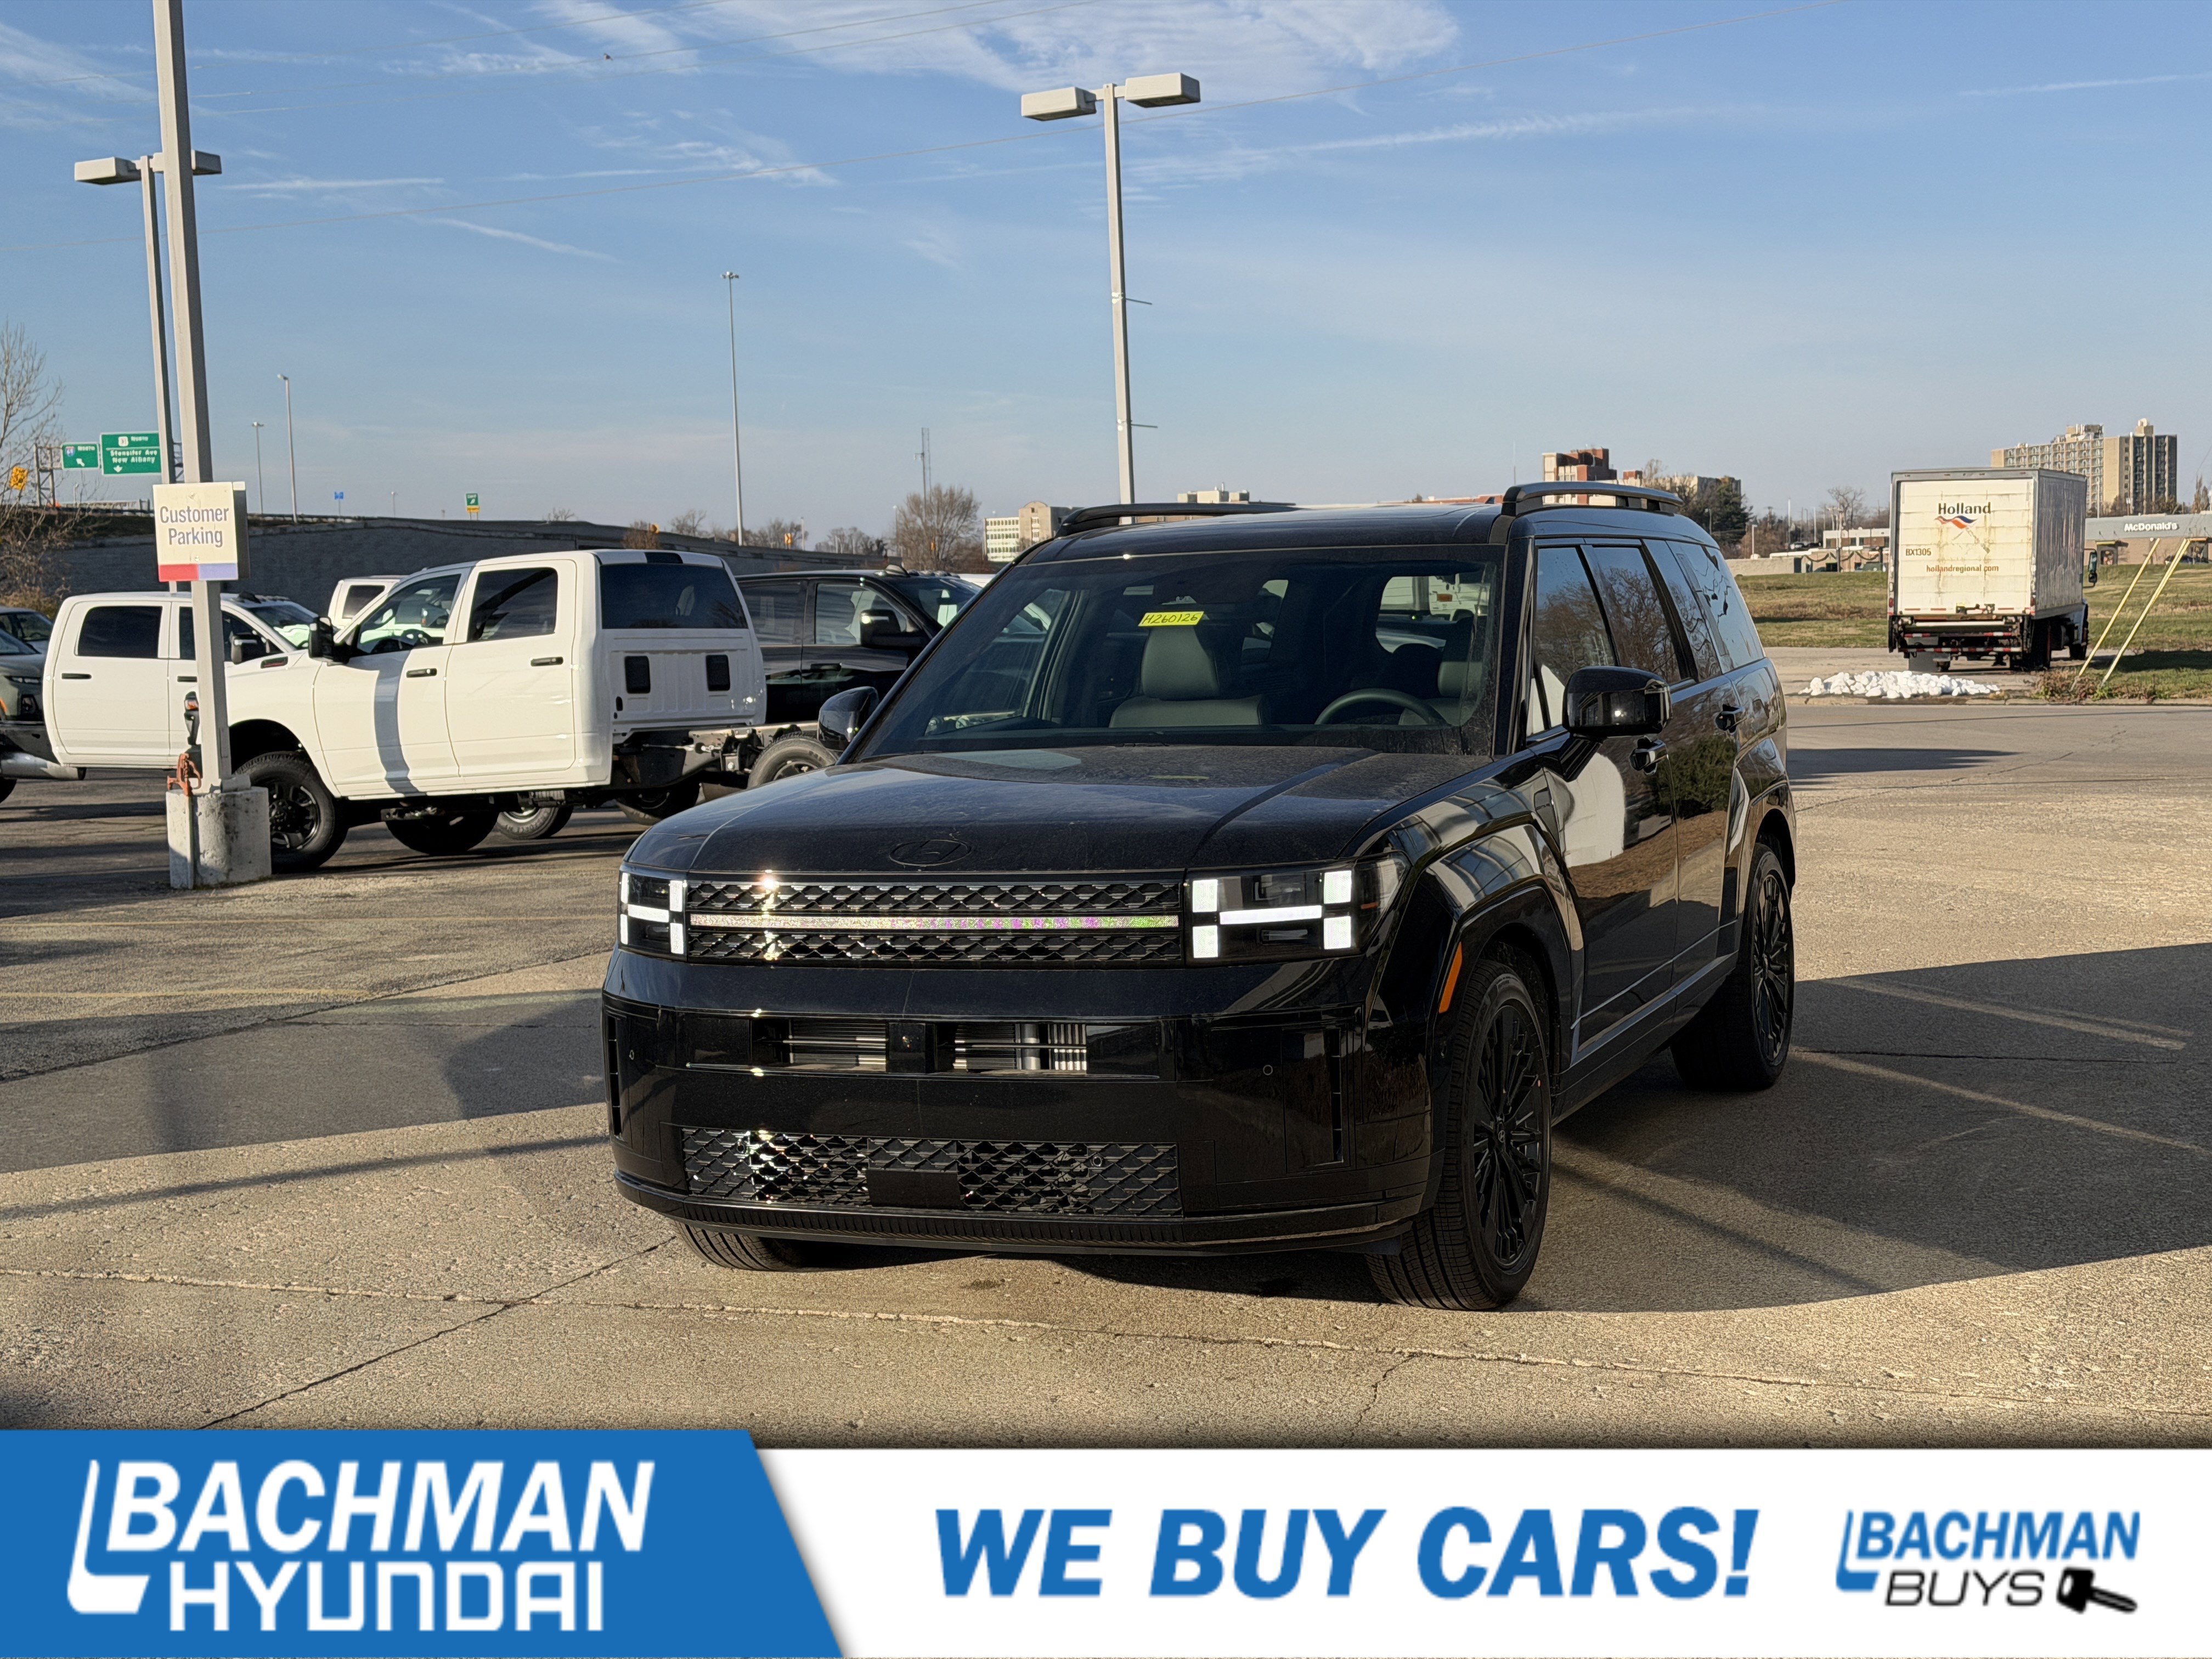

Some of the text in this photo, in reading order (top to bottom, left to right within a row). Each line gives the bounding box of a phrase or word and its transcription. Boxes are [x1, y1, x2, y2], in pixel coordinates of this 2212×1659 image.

[160, 505, 229, 523] Customer
[1938, 501, 1991, 515] Holland
[2124, 522, 2178, 532] McDonald's
[168, 527, 223, 548] Parking
[1926, 564, 1999, 573] hollandregionalcom
[1141, 613, 1198, 624] H260126
